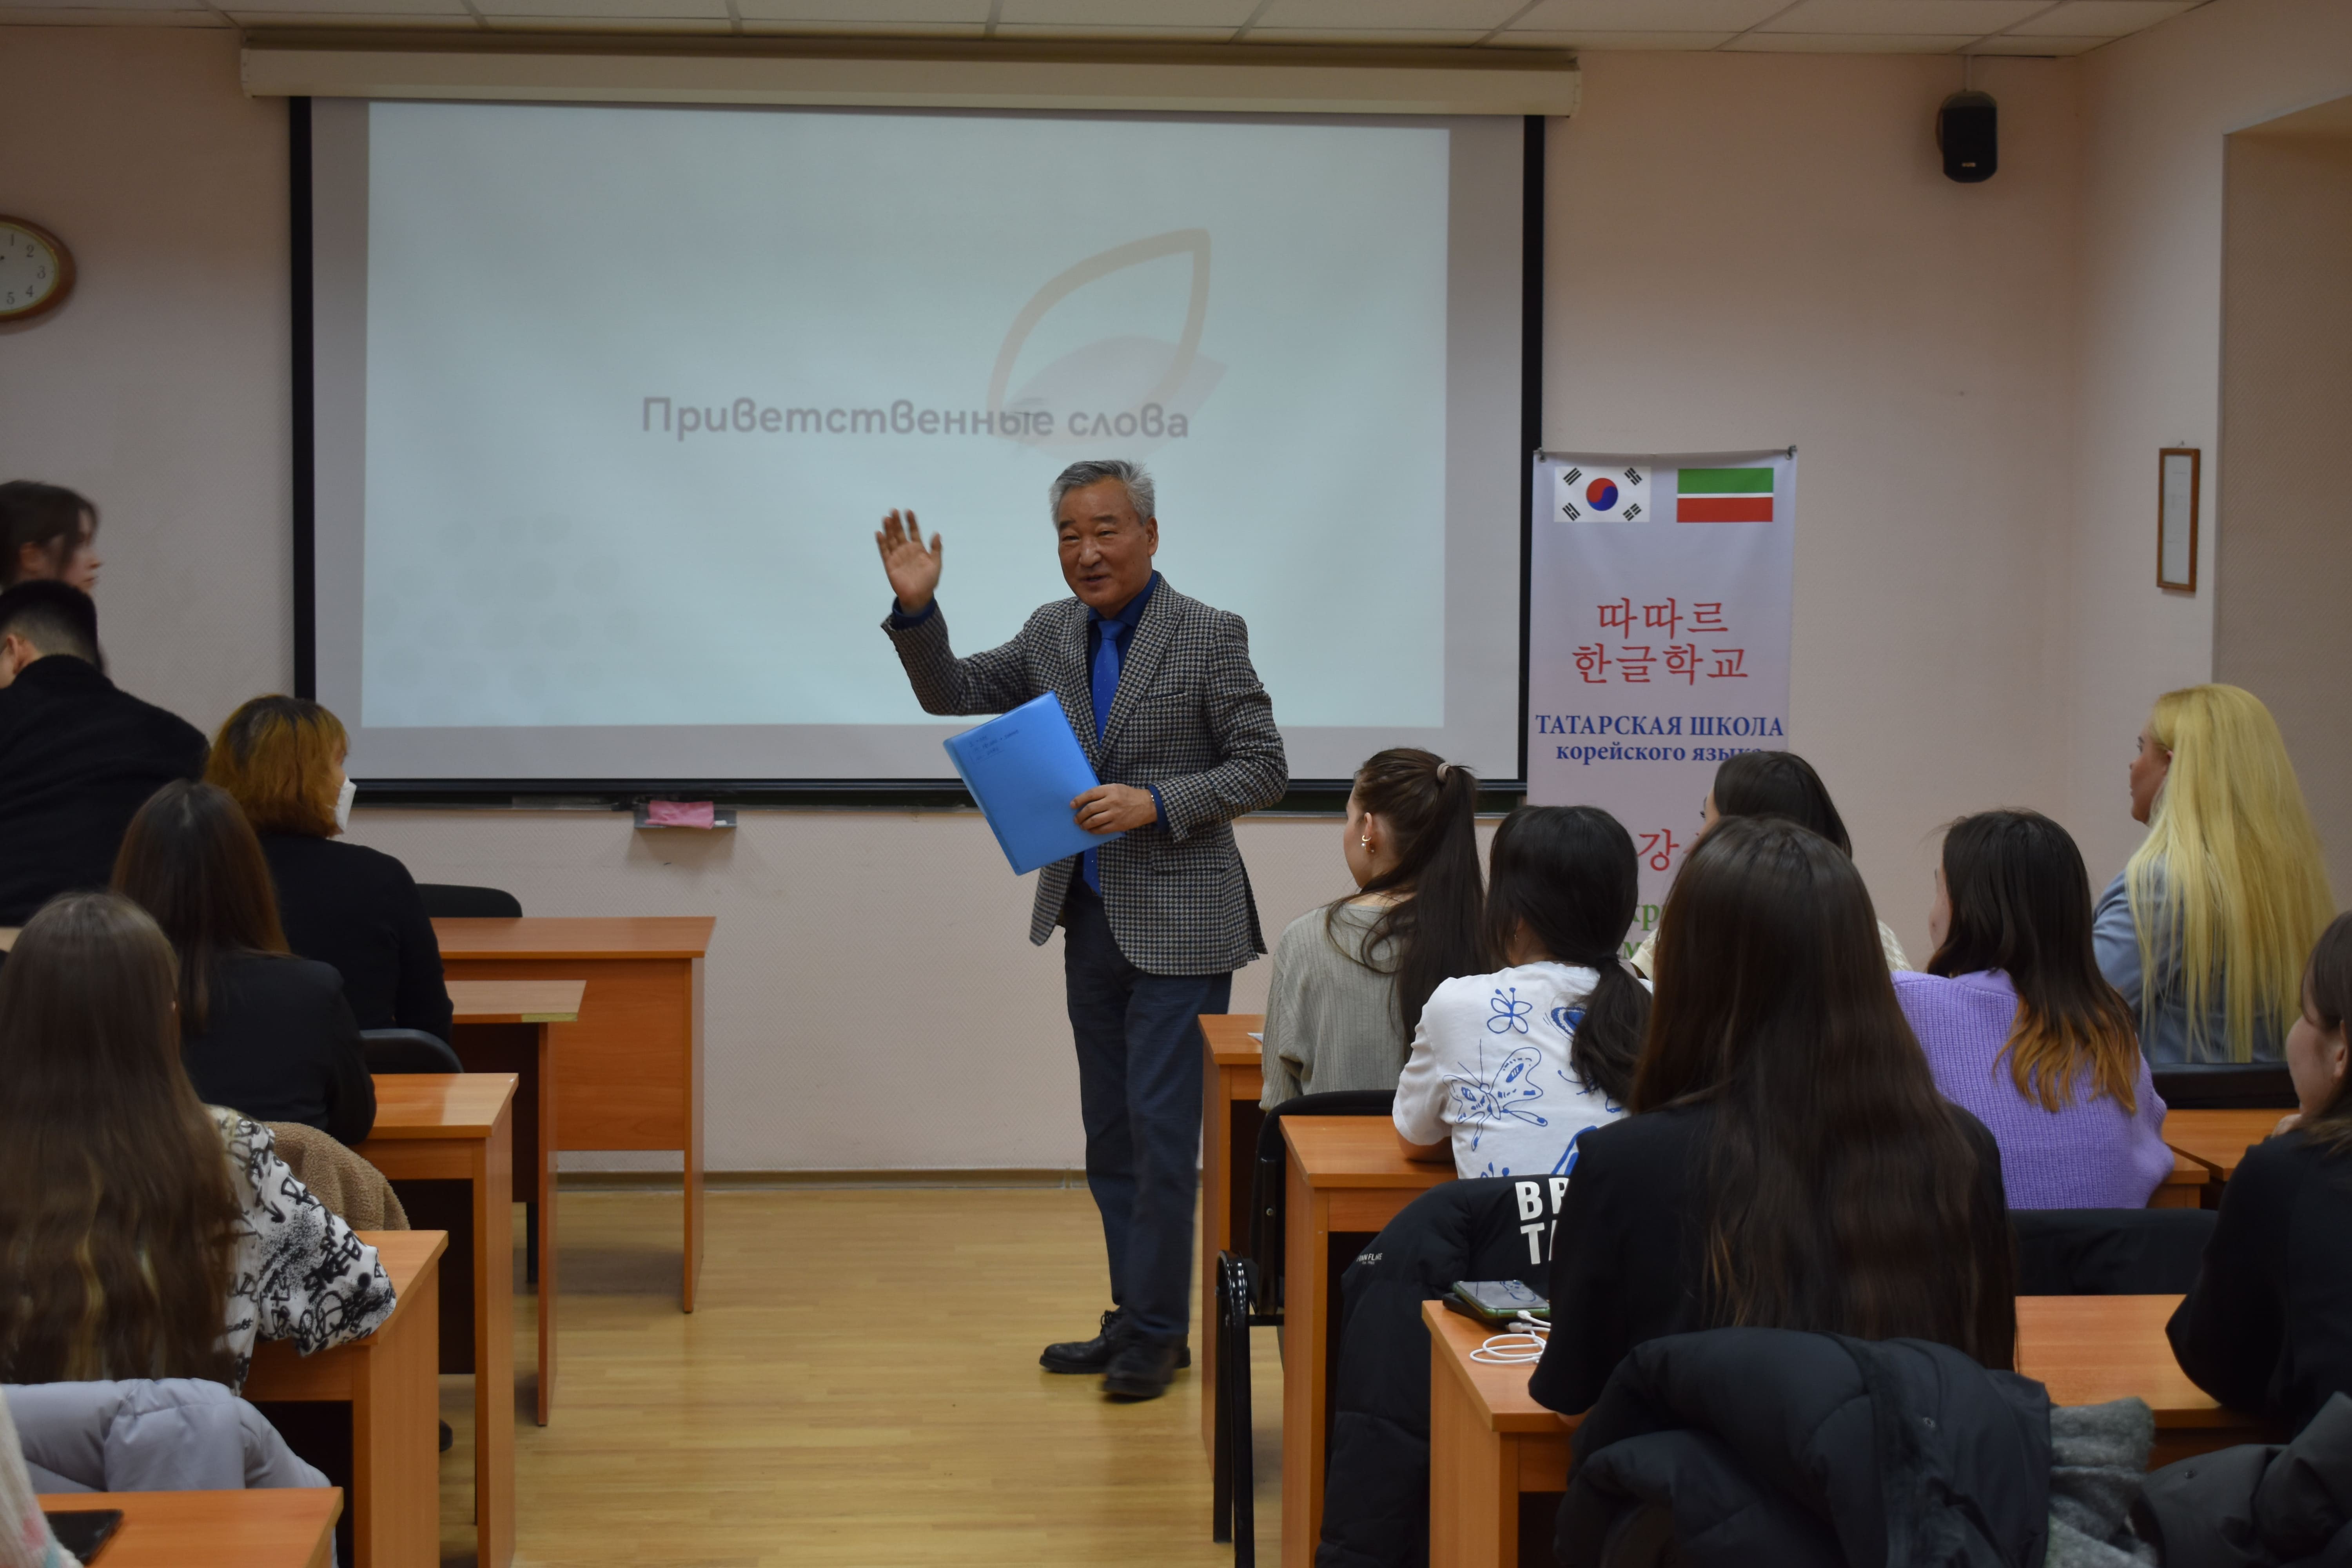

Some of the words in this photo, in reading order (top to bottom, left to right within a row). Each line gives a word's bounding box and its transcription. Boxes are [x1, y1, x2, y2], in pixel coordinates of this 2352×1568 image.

[10, 233, 15, 246] 1
[26, 244, 35, 258] 2
[37, 265, 46, 279] 3
[6, 292, 15, 305] 5
[25, 285, 34, 298] 4
[642, 396, 1054, 442] Приветственные
[1067, 402, 1189, 438] слова
[1597, 597, 1728, 639] 따따르
[1572, 642, 1748, 685] 한글학교
[1536, 715, 1682, 736] ТАТАРСКАЯ
[1691, 716, 1784, 737] ШКОЛА
[1556, 741, 1686, 766] корейского
[1692, 747, 1762, 761] язы
